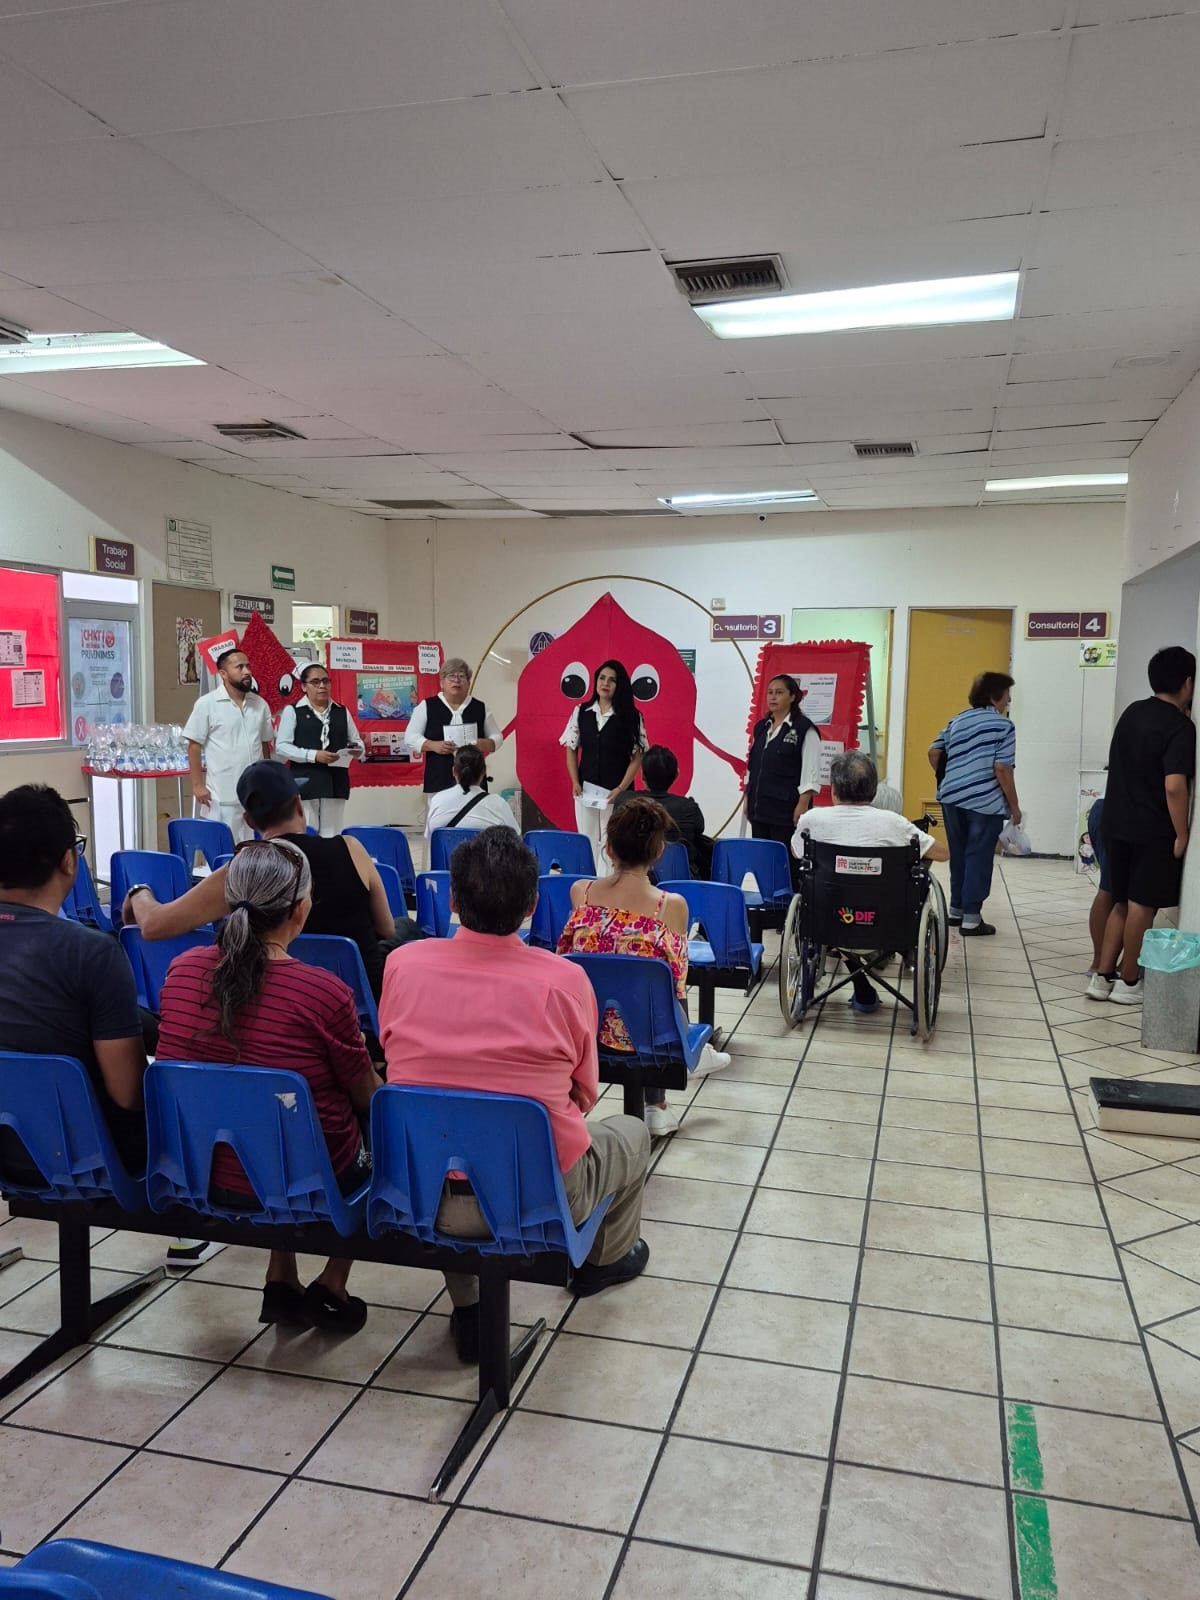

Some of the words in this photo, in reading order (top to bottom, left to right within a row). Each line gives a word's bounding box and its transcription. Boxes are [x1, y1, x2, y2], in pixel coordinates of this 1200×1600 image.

[102, 543, 128, 558] Trabajo
[105, 557, 126, 570] Social
[235, 599, 260, 610] JEFATURA
[370, 617, 376, 630] 2
[763, 619, 777, 634] 3
[1029, 620, 1079, 630] Consultorio
[1085, 617, 1101, 632] 4
[855, 911, 876, 922] DIF
